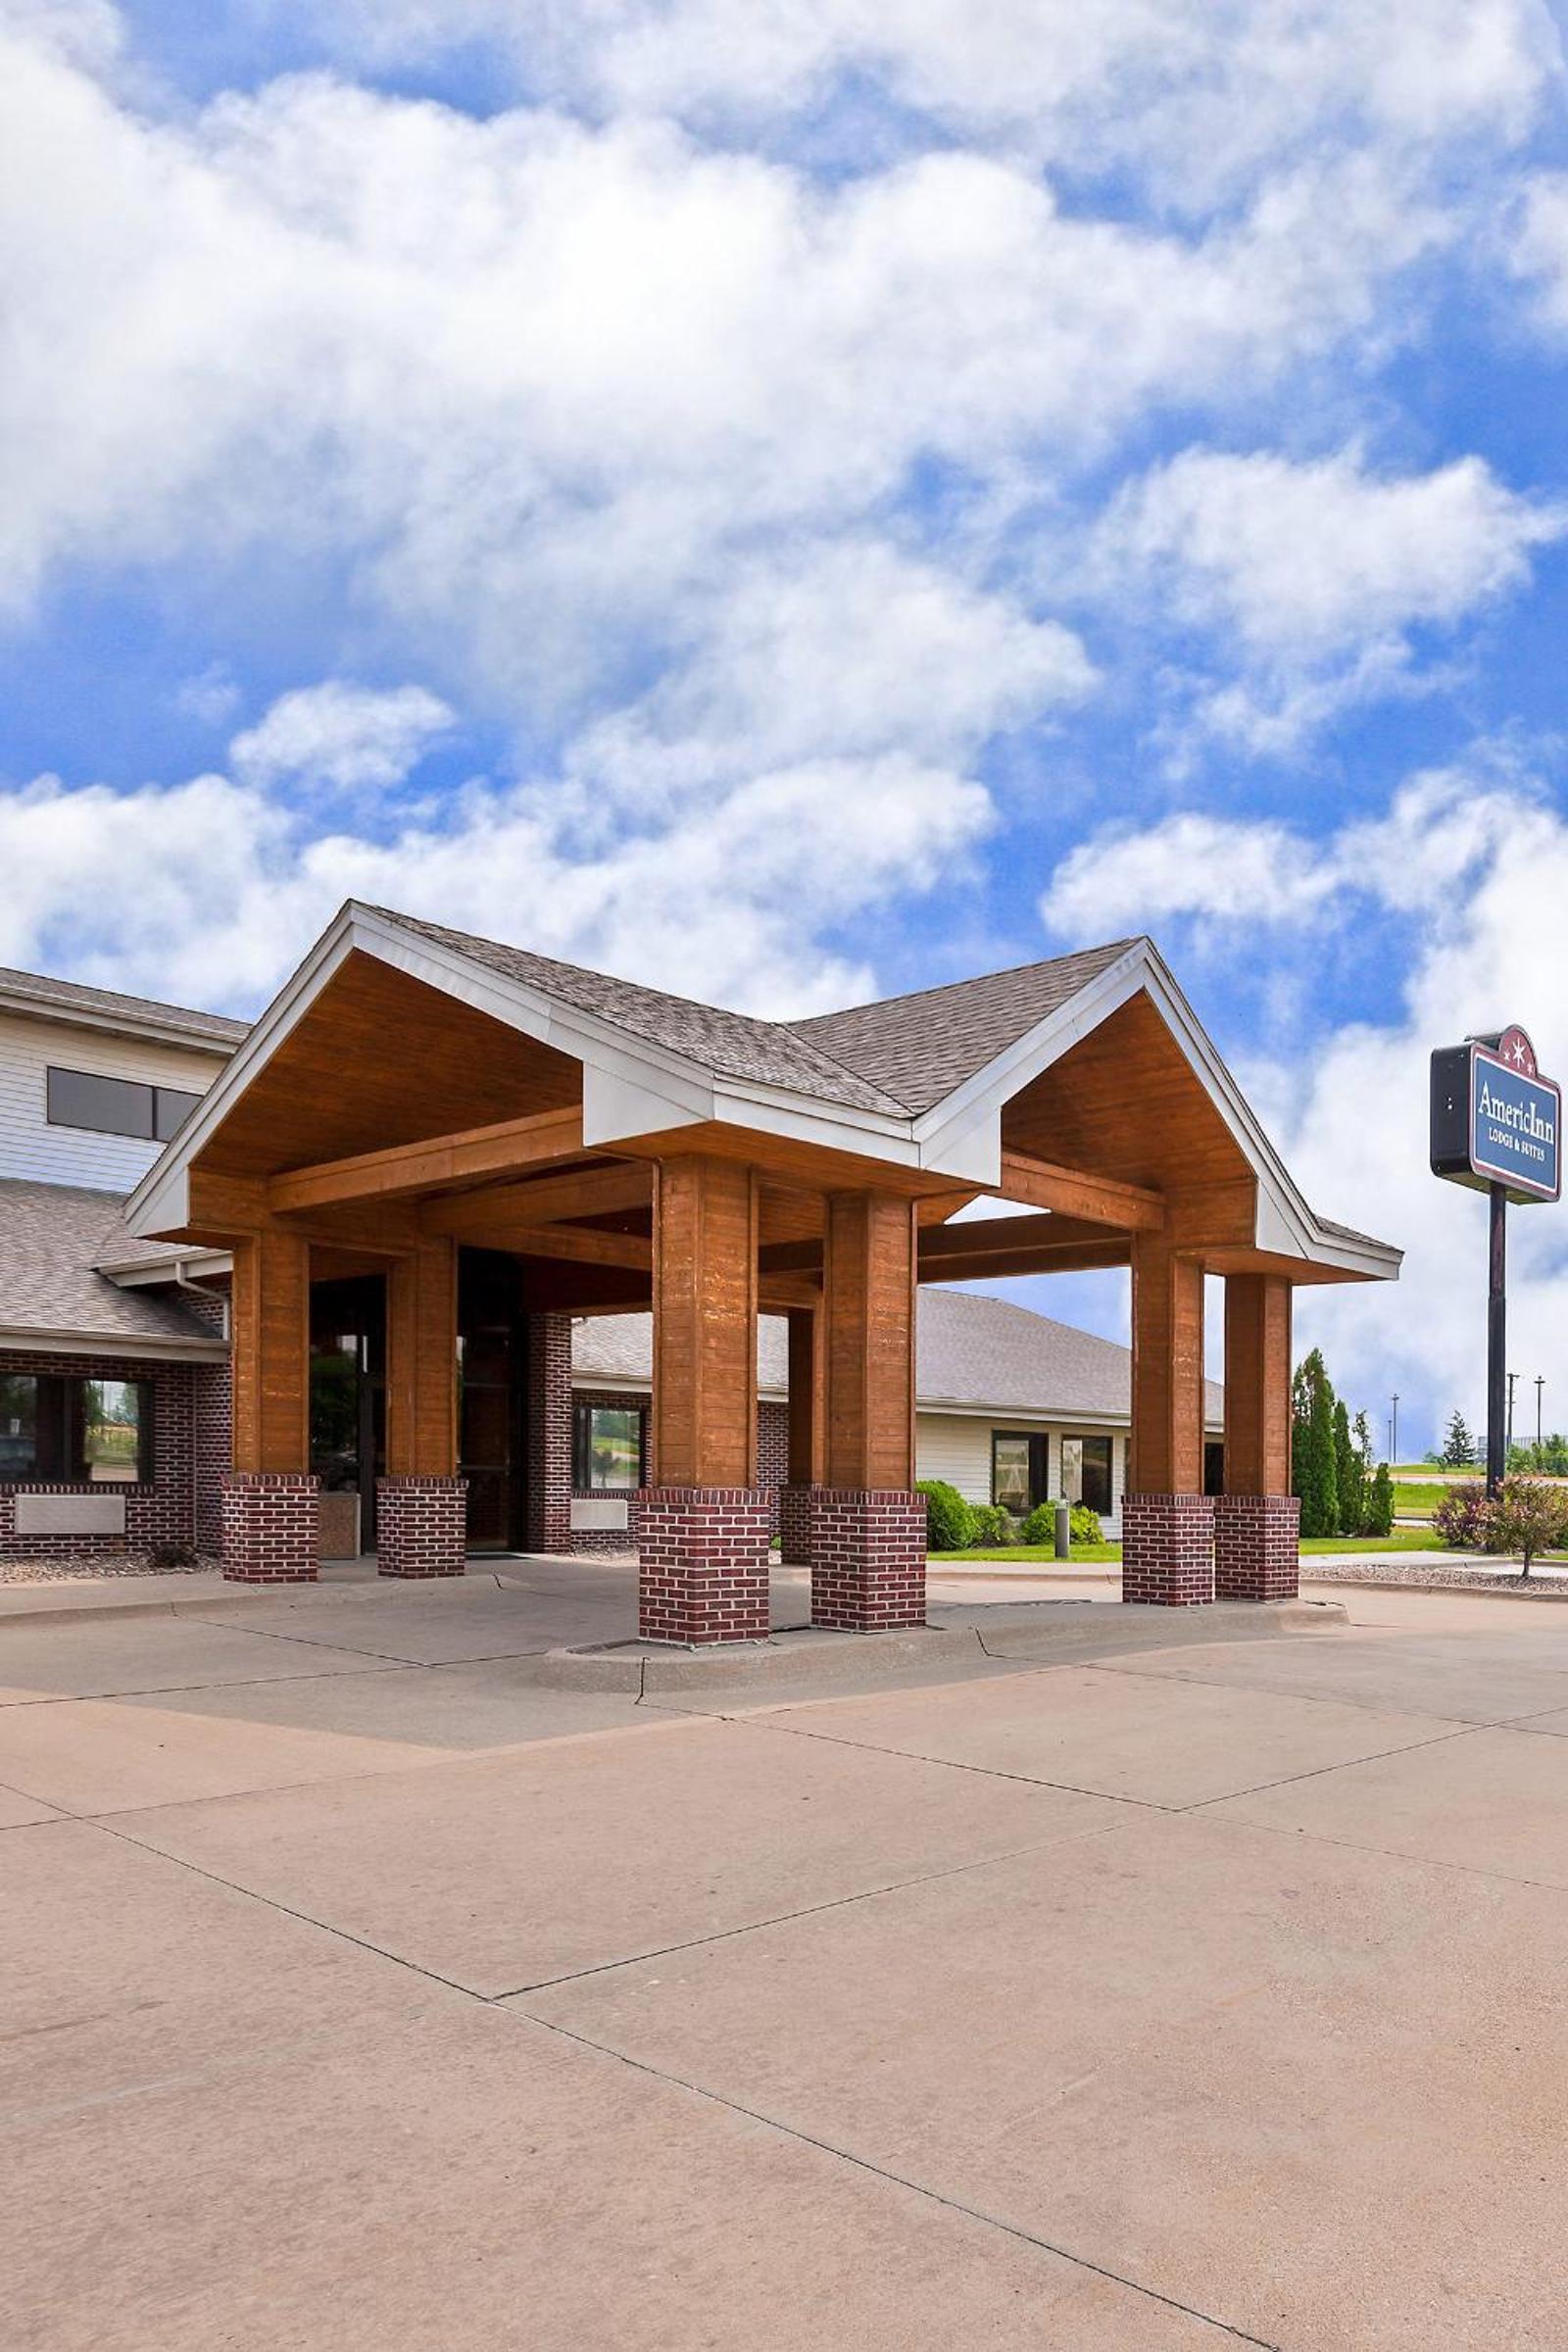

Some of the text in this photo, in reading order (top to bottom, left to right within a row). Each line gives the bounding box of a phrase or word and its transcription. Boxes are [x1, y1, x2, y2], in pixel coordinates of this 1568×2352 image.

[1478, 1081, 1554, 1145] AmericInn
[1489, 1126, 1545, 1162] LODGE & SUITES
